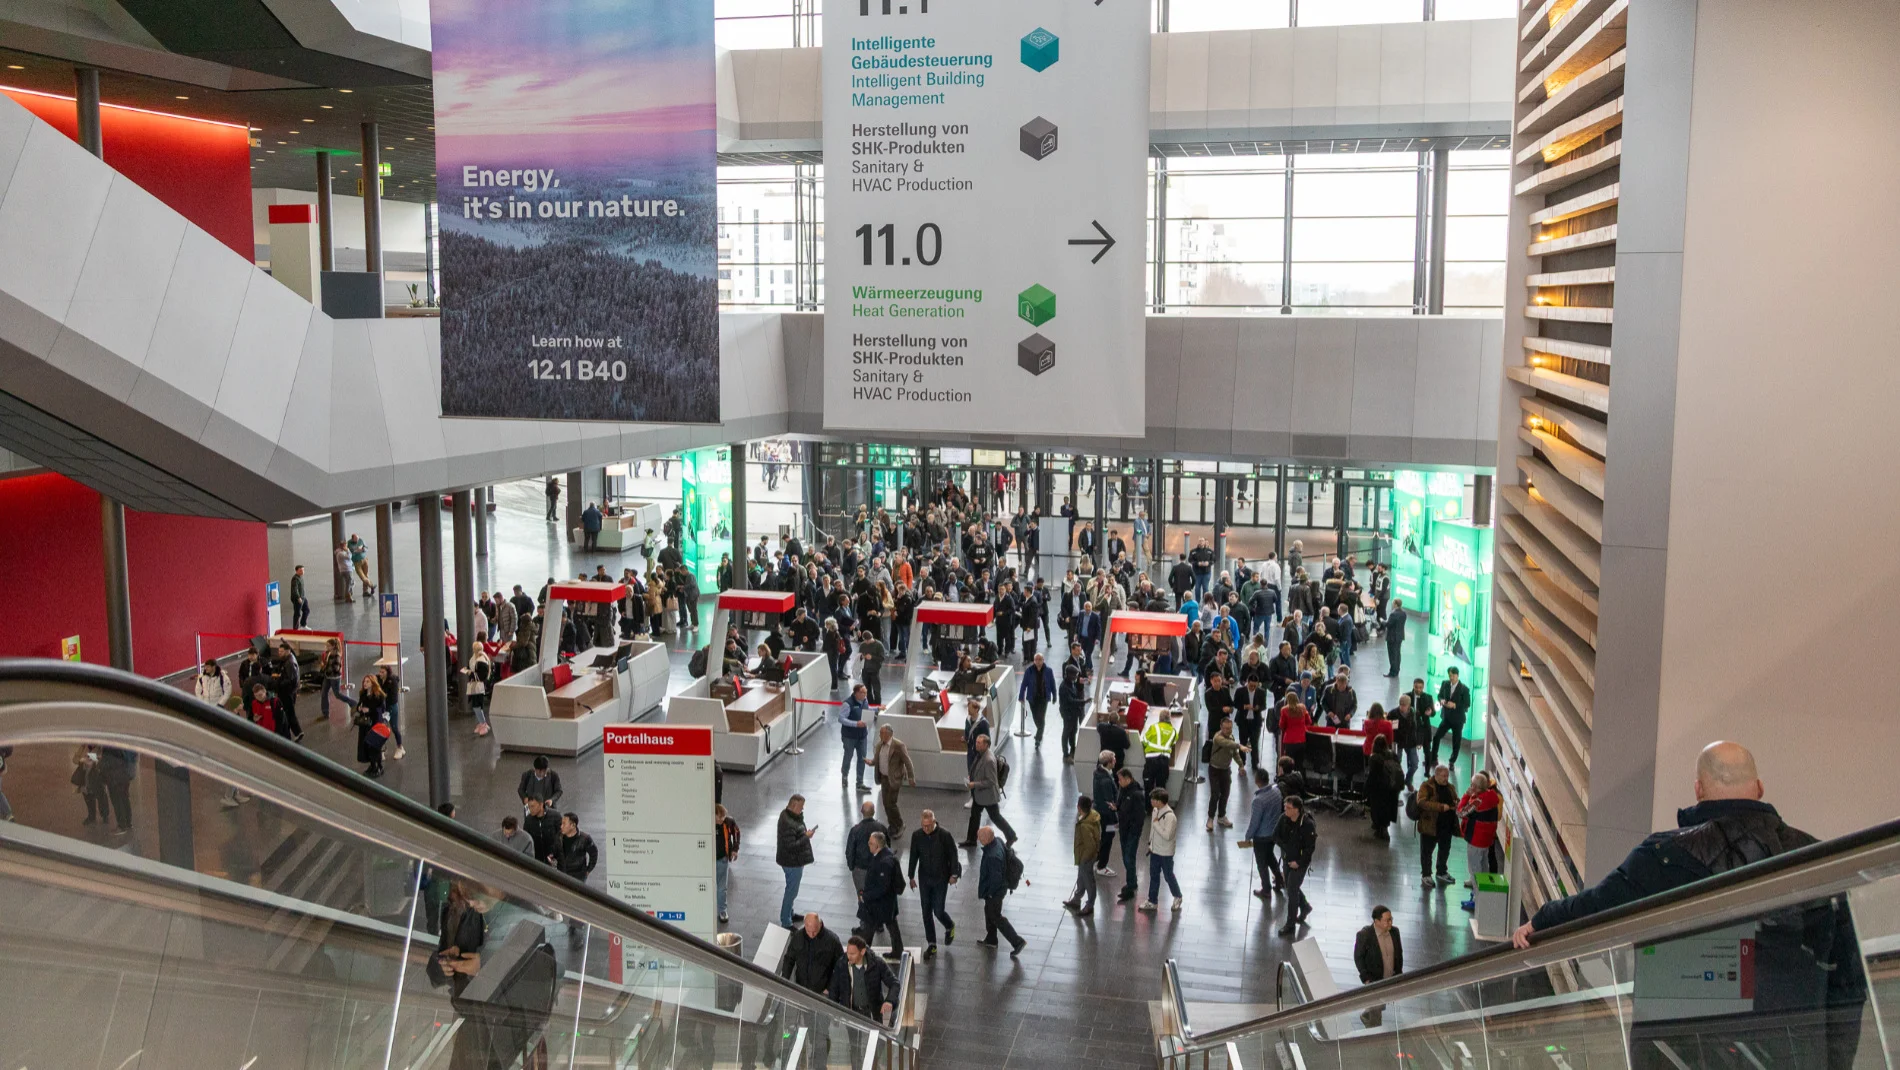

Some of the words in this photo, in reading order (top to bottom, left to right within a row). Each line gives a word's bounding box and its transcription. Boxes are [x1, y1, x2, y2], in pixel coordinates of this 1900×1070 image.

[851, 36, 936, 52] Intelligente
[851, 51, 993, 69] Gebäudesteuerung
[852, 73, 922, 90] Intelligent
[926, 71, 985, 87] Building
[852, 92, 945, 108] Management
[852, 122, 937, 138] Herstellung
[941, 124, 969, 135] von
[852, 140, 965, 155] SHK-Produkten
[852, 160, 908, 176] Sanitary
[913, 159, 924, 173] &
[463, 165, 560, 192] Energy,
[852, 178, 892, 192] HVAC
[897, 177, 973, 191] Production
[509, 196, 532, 218] in
[538, 200, 582, 217] our
[588, 196, 685, 217] nature.
[855, 222, 943, 266] 11.0
[852, 285, 983, 302] Wärmeerzeugung
[852, 303, 885, 317] Heat
[888, 303, 965, 318] Generation
[531, 335, 572, 348] Learn
[575, 335, 604, 348] how
[607, 336, 622, 348] at
[853, 333, 936, 350] Herstellung
[941, 337, 968, 348] von
[852, 351, 964, 366] SHK-Produkten
[527, 359, 571, 380] 12.1
[578, 360, 627, 381] B40
[853, 368, 908, 385] Sanitary
[913, 369, 924, 383] &
[853, 387, 892, 401] HVAC
[897, 387, 972, 402] Production
[606, 732, 674, 745] Portalhaus
[608, 759, 615, 769] C
[612, 837, 616, 846] 1
